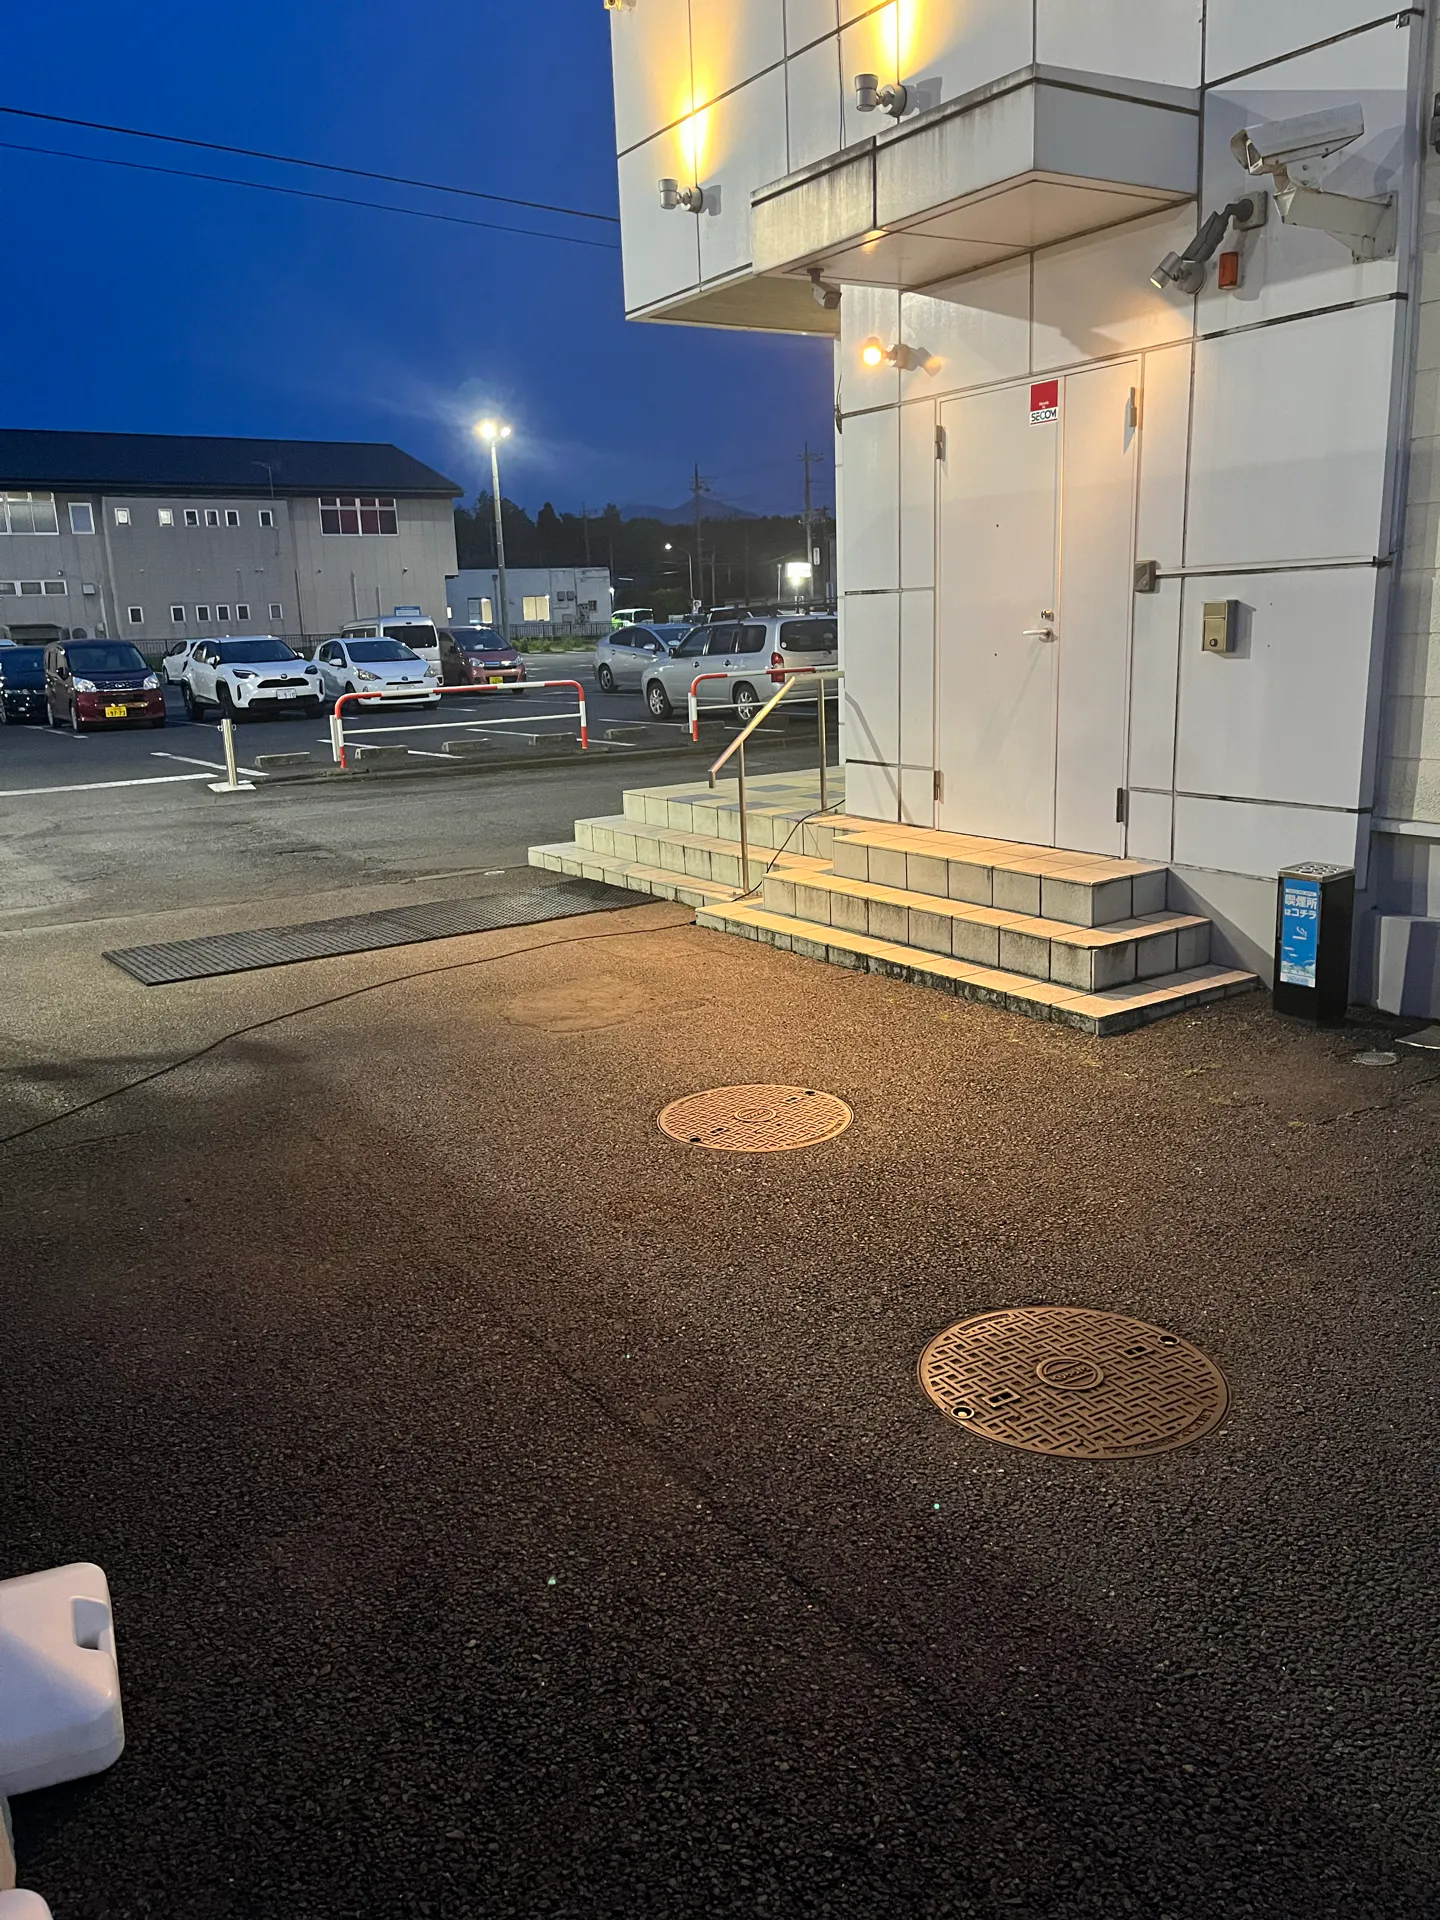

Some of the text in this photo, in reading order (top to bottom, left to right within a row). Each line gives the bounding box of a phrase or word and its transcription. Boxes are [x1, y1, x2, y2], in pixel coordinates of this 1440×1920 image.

[1031, 409, 1056, 421] SECOM
[1285, 894, 1317, 910] 喫煙所
[1284, 908, 1317, 920] はコチラ
